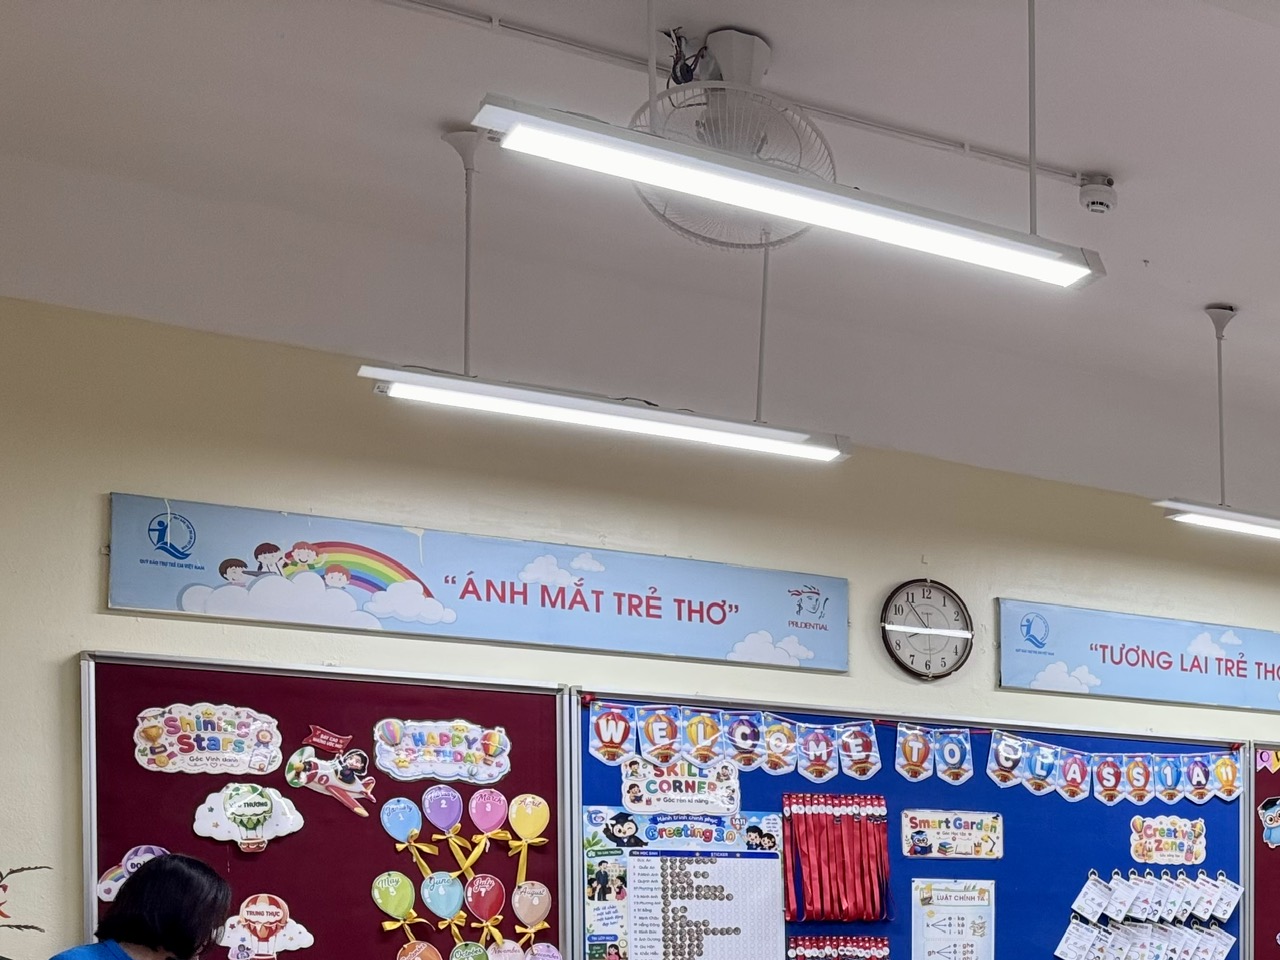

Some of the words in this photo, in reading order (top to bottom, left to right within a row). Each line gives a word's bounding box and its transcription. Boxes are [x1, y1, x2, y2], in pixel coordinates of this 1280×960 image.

[540, 577, 604, 613] MẮT
[613, 586, 663, 620] TRẺ
[905, 591, 915, 603] 11
[921, 588, 932, 600] 12
[942, 596, 947, 608] 1
[893, 604, 904, 616] 10
[954, 611, 960, 622] 2
[788, 620, 829, 631] PRUDENTIAL
[895, 639, 902, 651] 8
[953, 644, 959, 656] 4
[909, 654, 915, 665] 7
[924, 659, 931, 670] 6
[940, 657, 947, 668] 5
[1179, 653, 1209, 674] LAI
[1214, 652, 1248, 679] TRẺ
[163, 714, 252, 738] Shining
[176, 733, 245, 754] Stars
[411, 731, 479, 750] HAPPY
[598, 719, 865, 760] WELCOME
[908, 740, 961, 765] TO
[999, 740, 1145, 788] CLASS
[652, 762, 709, 778] SKILL
[645, 779, 718, 795] CORNER
[440, 800, 448, 809] 2
[485, 803, 492, 812] 3
[732, 817, 746, 825] 1A11
[909, 816, 951, 829] Smart
[952, 816, 997, 834] Garden
[645, 823, 713, 843] Greeting
[714, 827, 737, 843] 3.0
[1143, 824, 1194, 841] Creative
[1154, 839, 1185, 852] Zone
[378, 877, 400, 888] May
[473, 877, 495, 893] July
[480, 887, 486, 898] 7
[953, 894, 976, 902] CHÍNH
[453, 947, 483, 960] October
